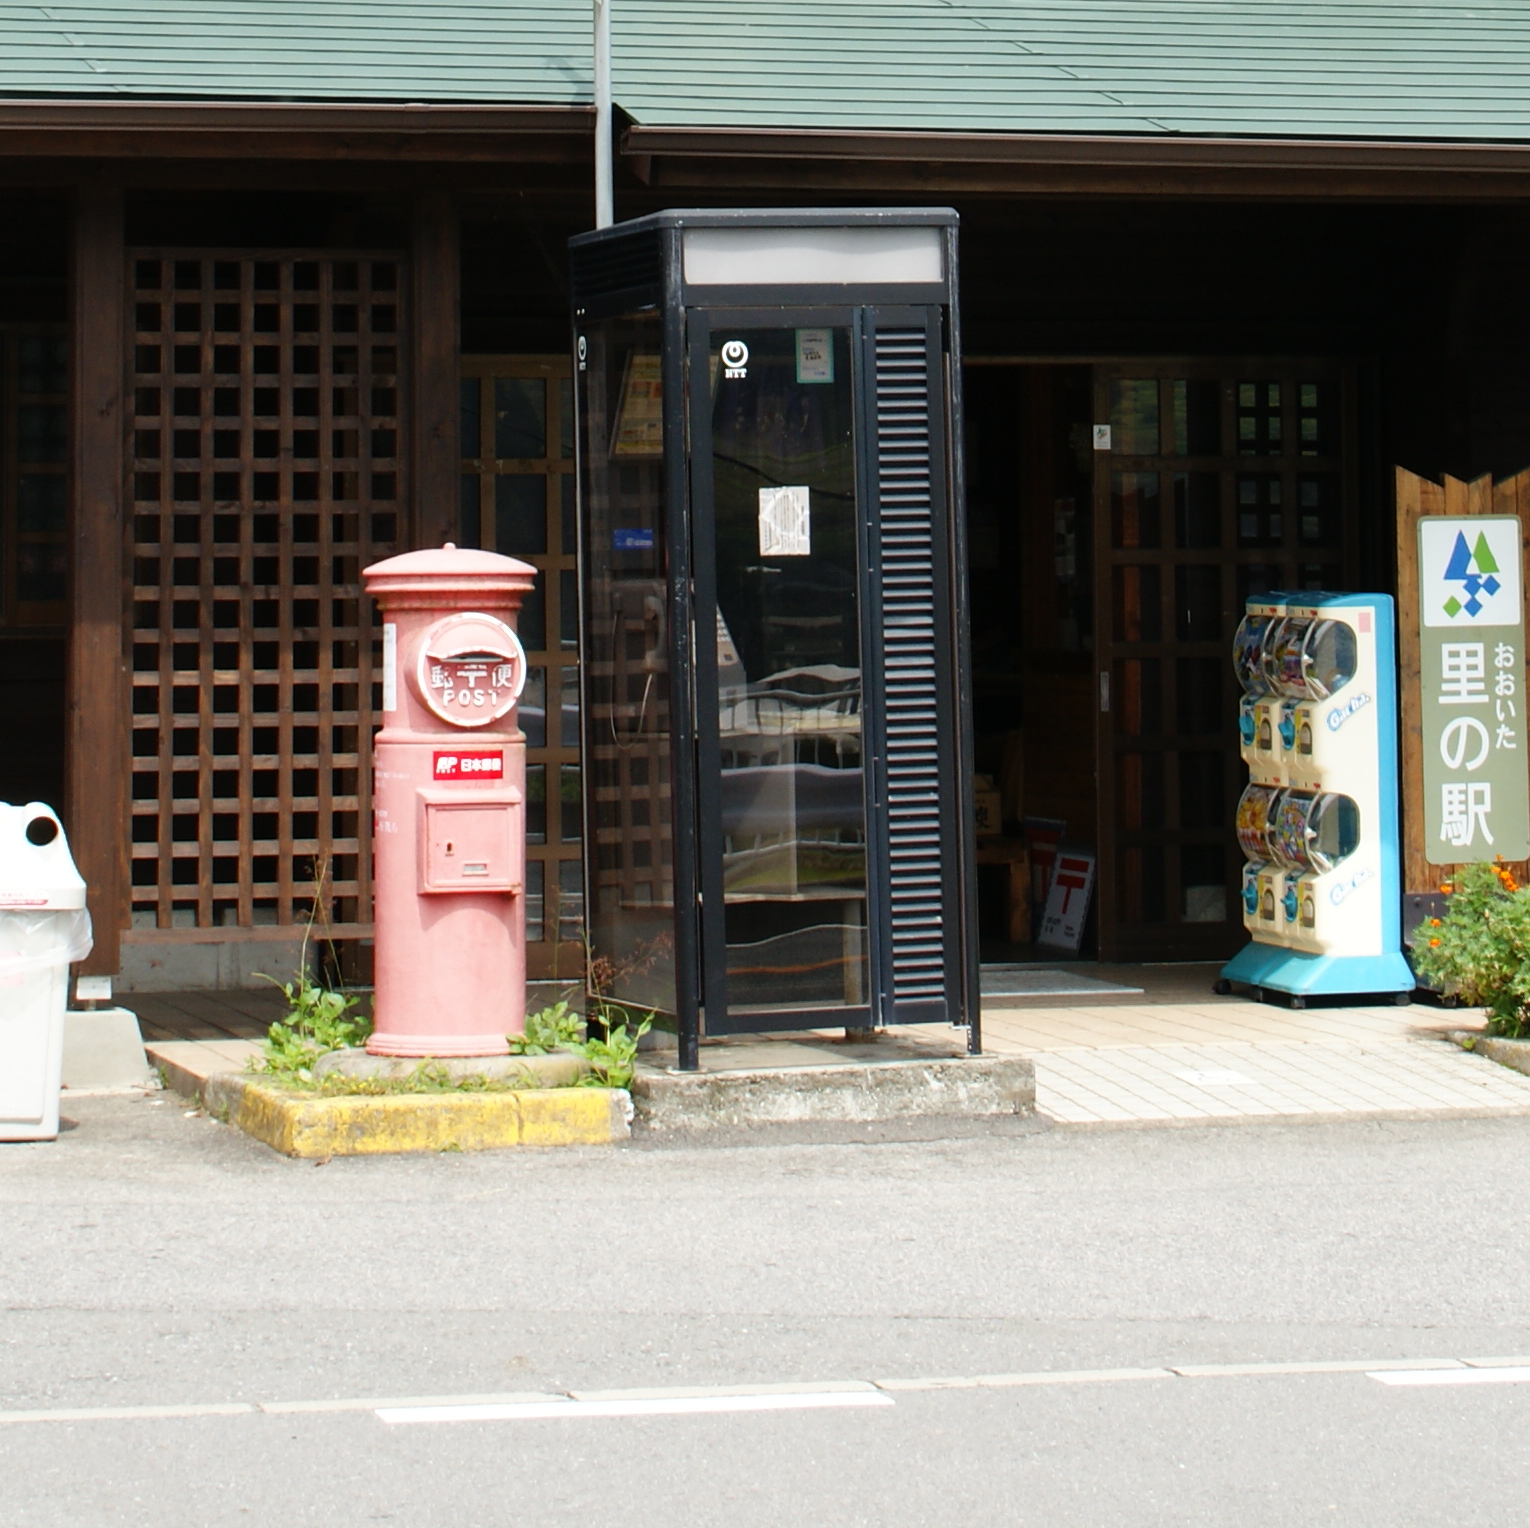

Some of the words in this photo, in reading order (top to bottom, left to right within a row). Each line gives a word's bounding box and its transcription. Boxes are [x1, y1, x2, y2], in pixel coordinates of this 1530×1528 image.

[724, 368, 748, 379] NTT
[442, 688, 501, 708] POST
[1493, 641, 1517, 750] おおいた
[1438, 641, 1494, 847] 里の駅
[460, 757, 501, 772] 日本郵便
